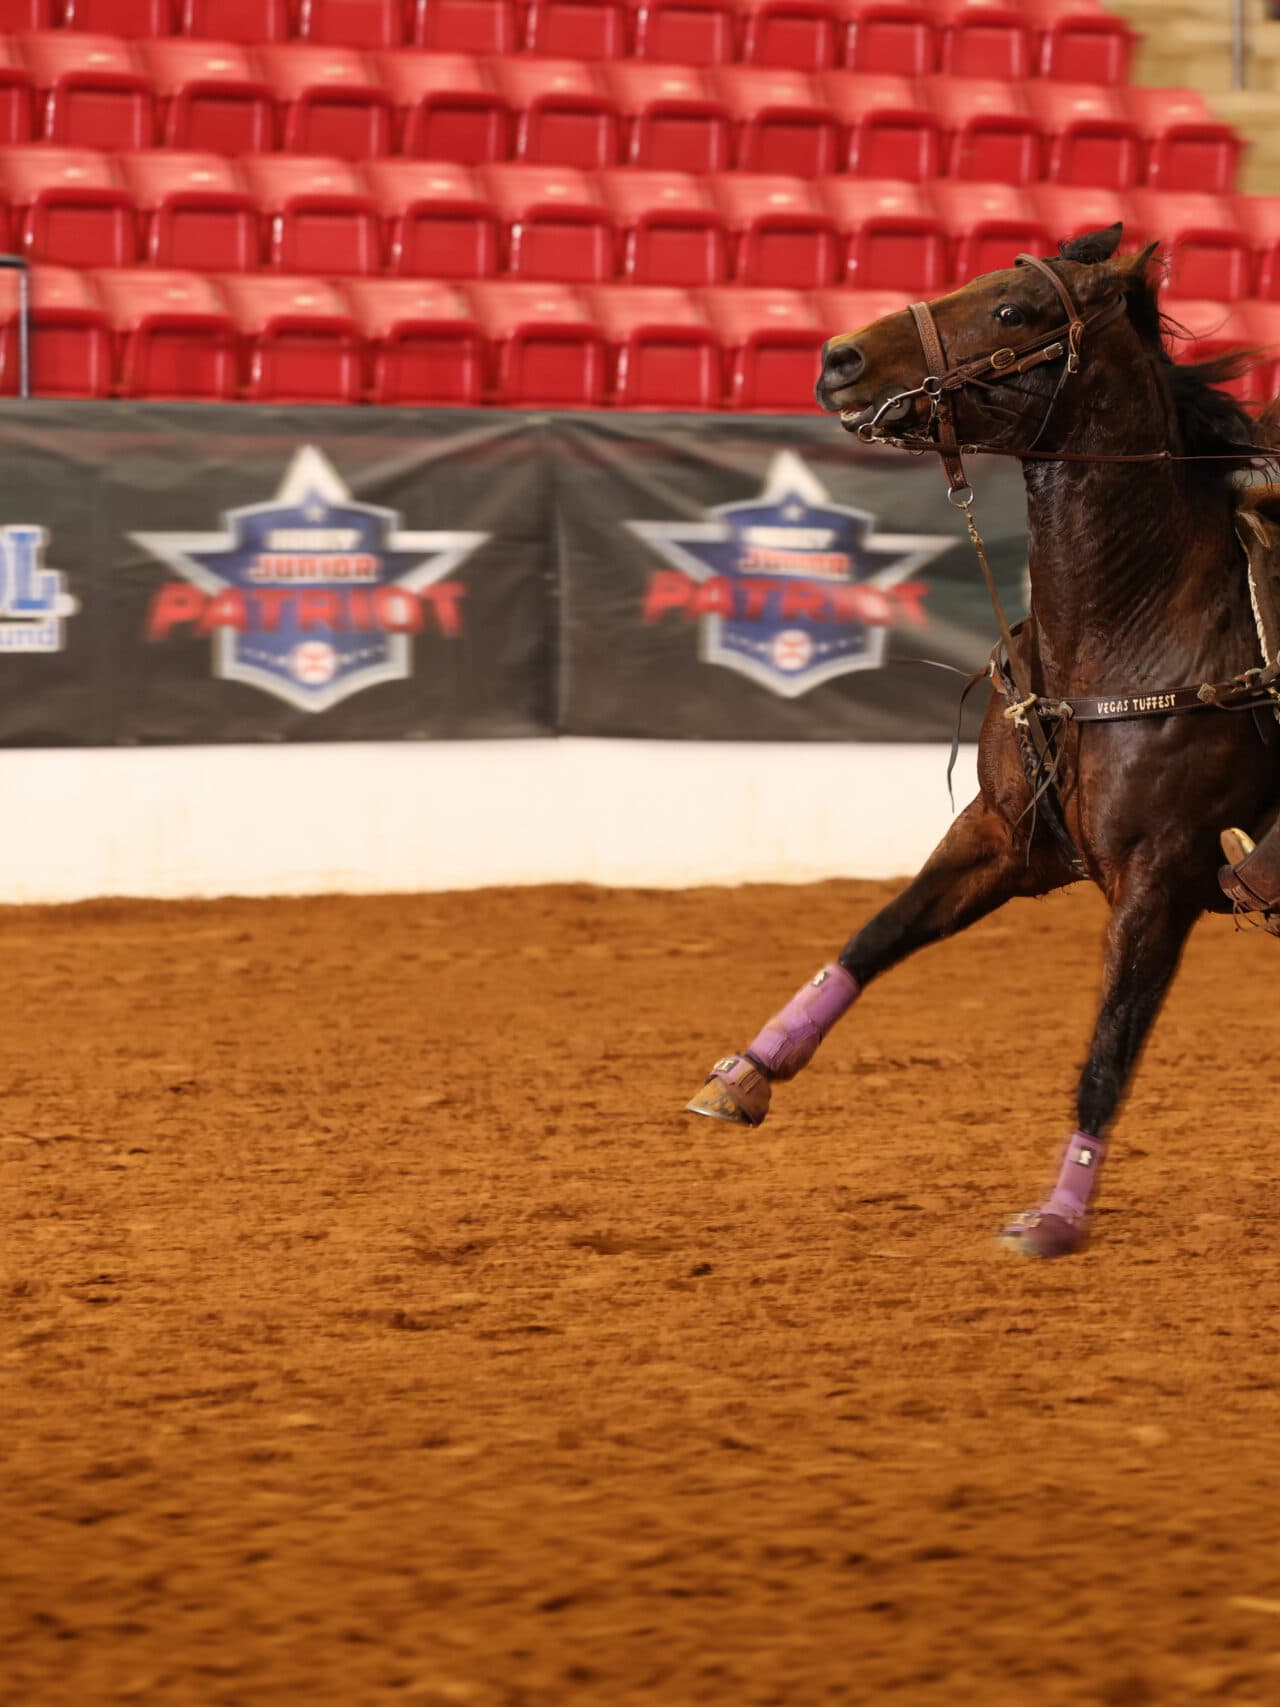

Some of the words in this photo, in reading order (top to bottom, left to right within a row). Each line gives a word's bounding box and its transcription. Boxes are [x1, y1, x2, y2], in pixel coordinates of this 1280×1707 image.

[146, 581, 468, 640] PATRIOT
[643, 568, 930, 628] PATRIOT
[1097, 699, 1129, 714] VEGAS
[1132, 694, 1176, 711] TUFFEST
